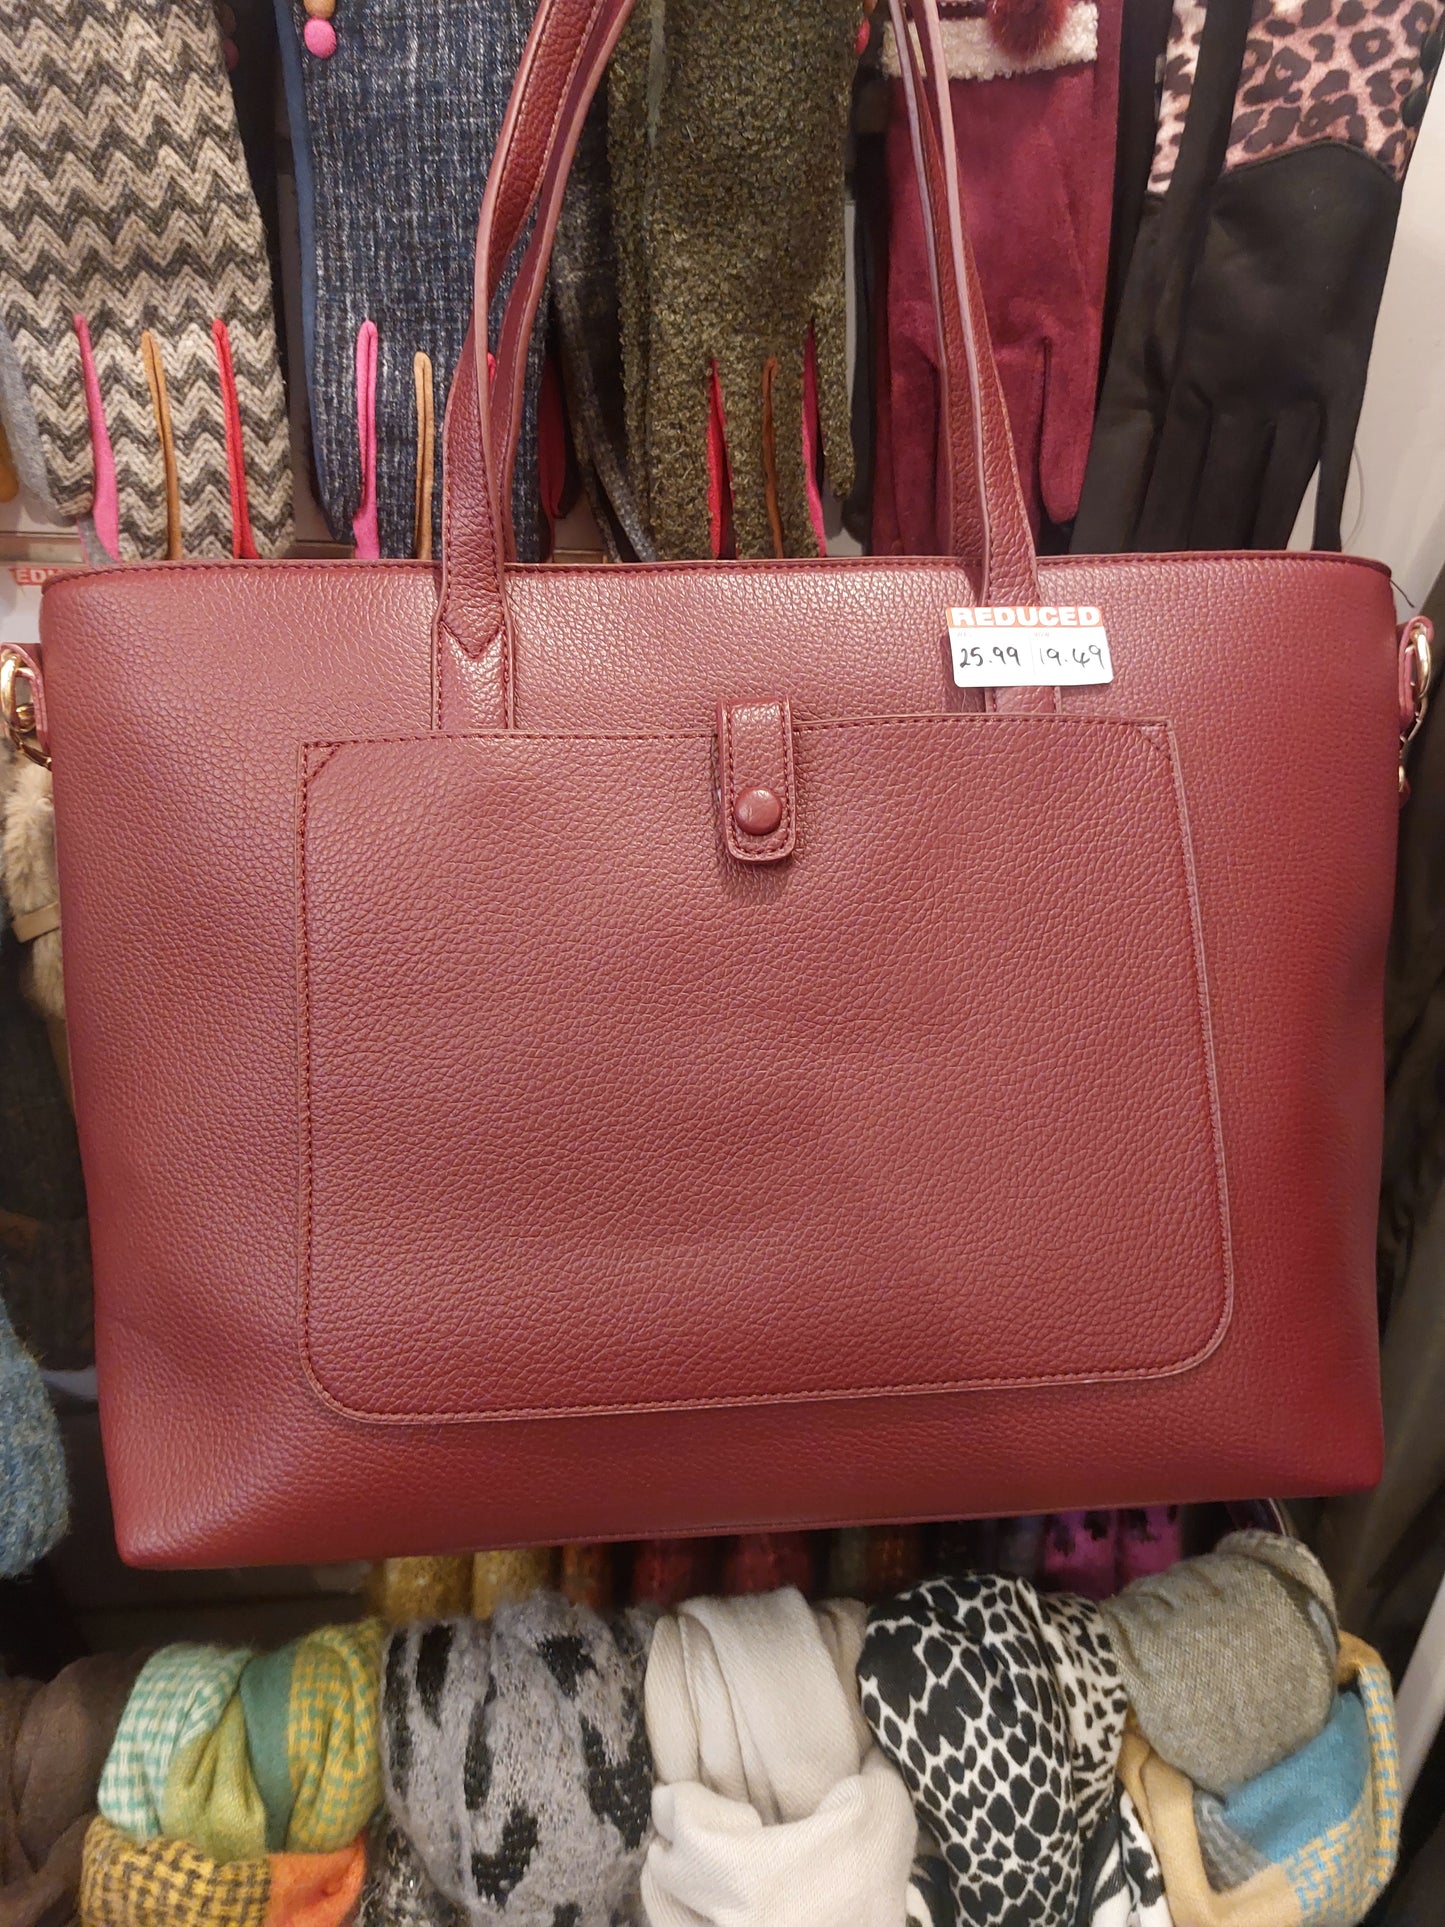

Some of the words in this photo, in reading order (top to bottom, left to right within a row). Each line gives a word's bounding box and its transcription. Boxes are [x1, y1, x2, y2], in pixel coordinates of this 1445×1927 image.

[951, 606, 1101, 627] REDUCED
[959, 646, 1022, 669] 25.99
[1039, 644, 1105, 670] 19.49
